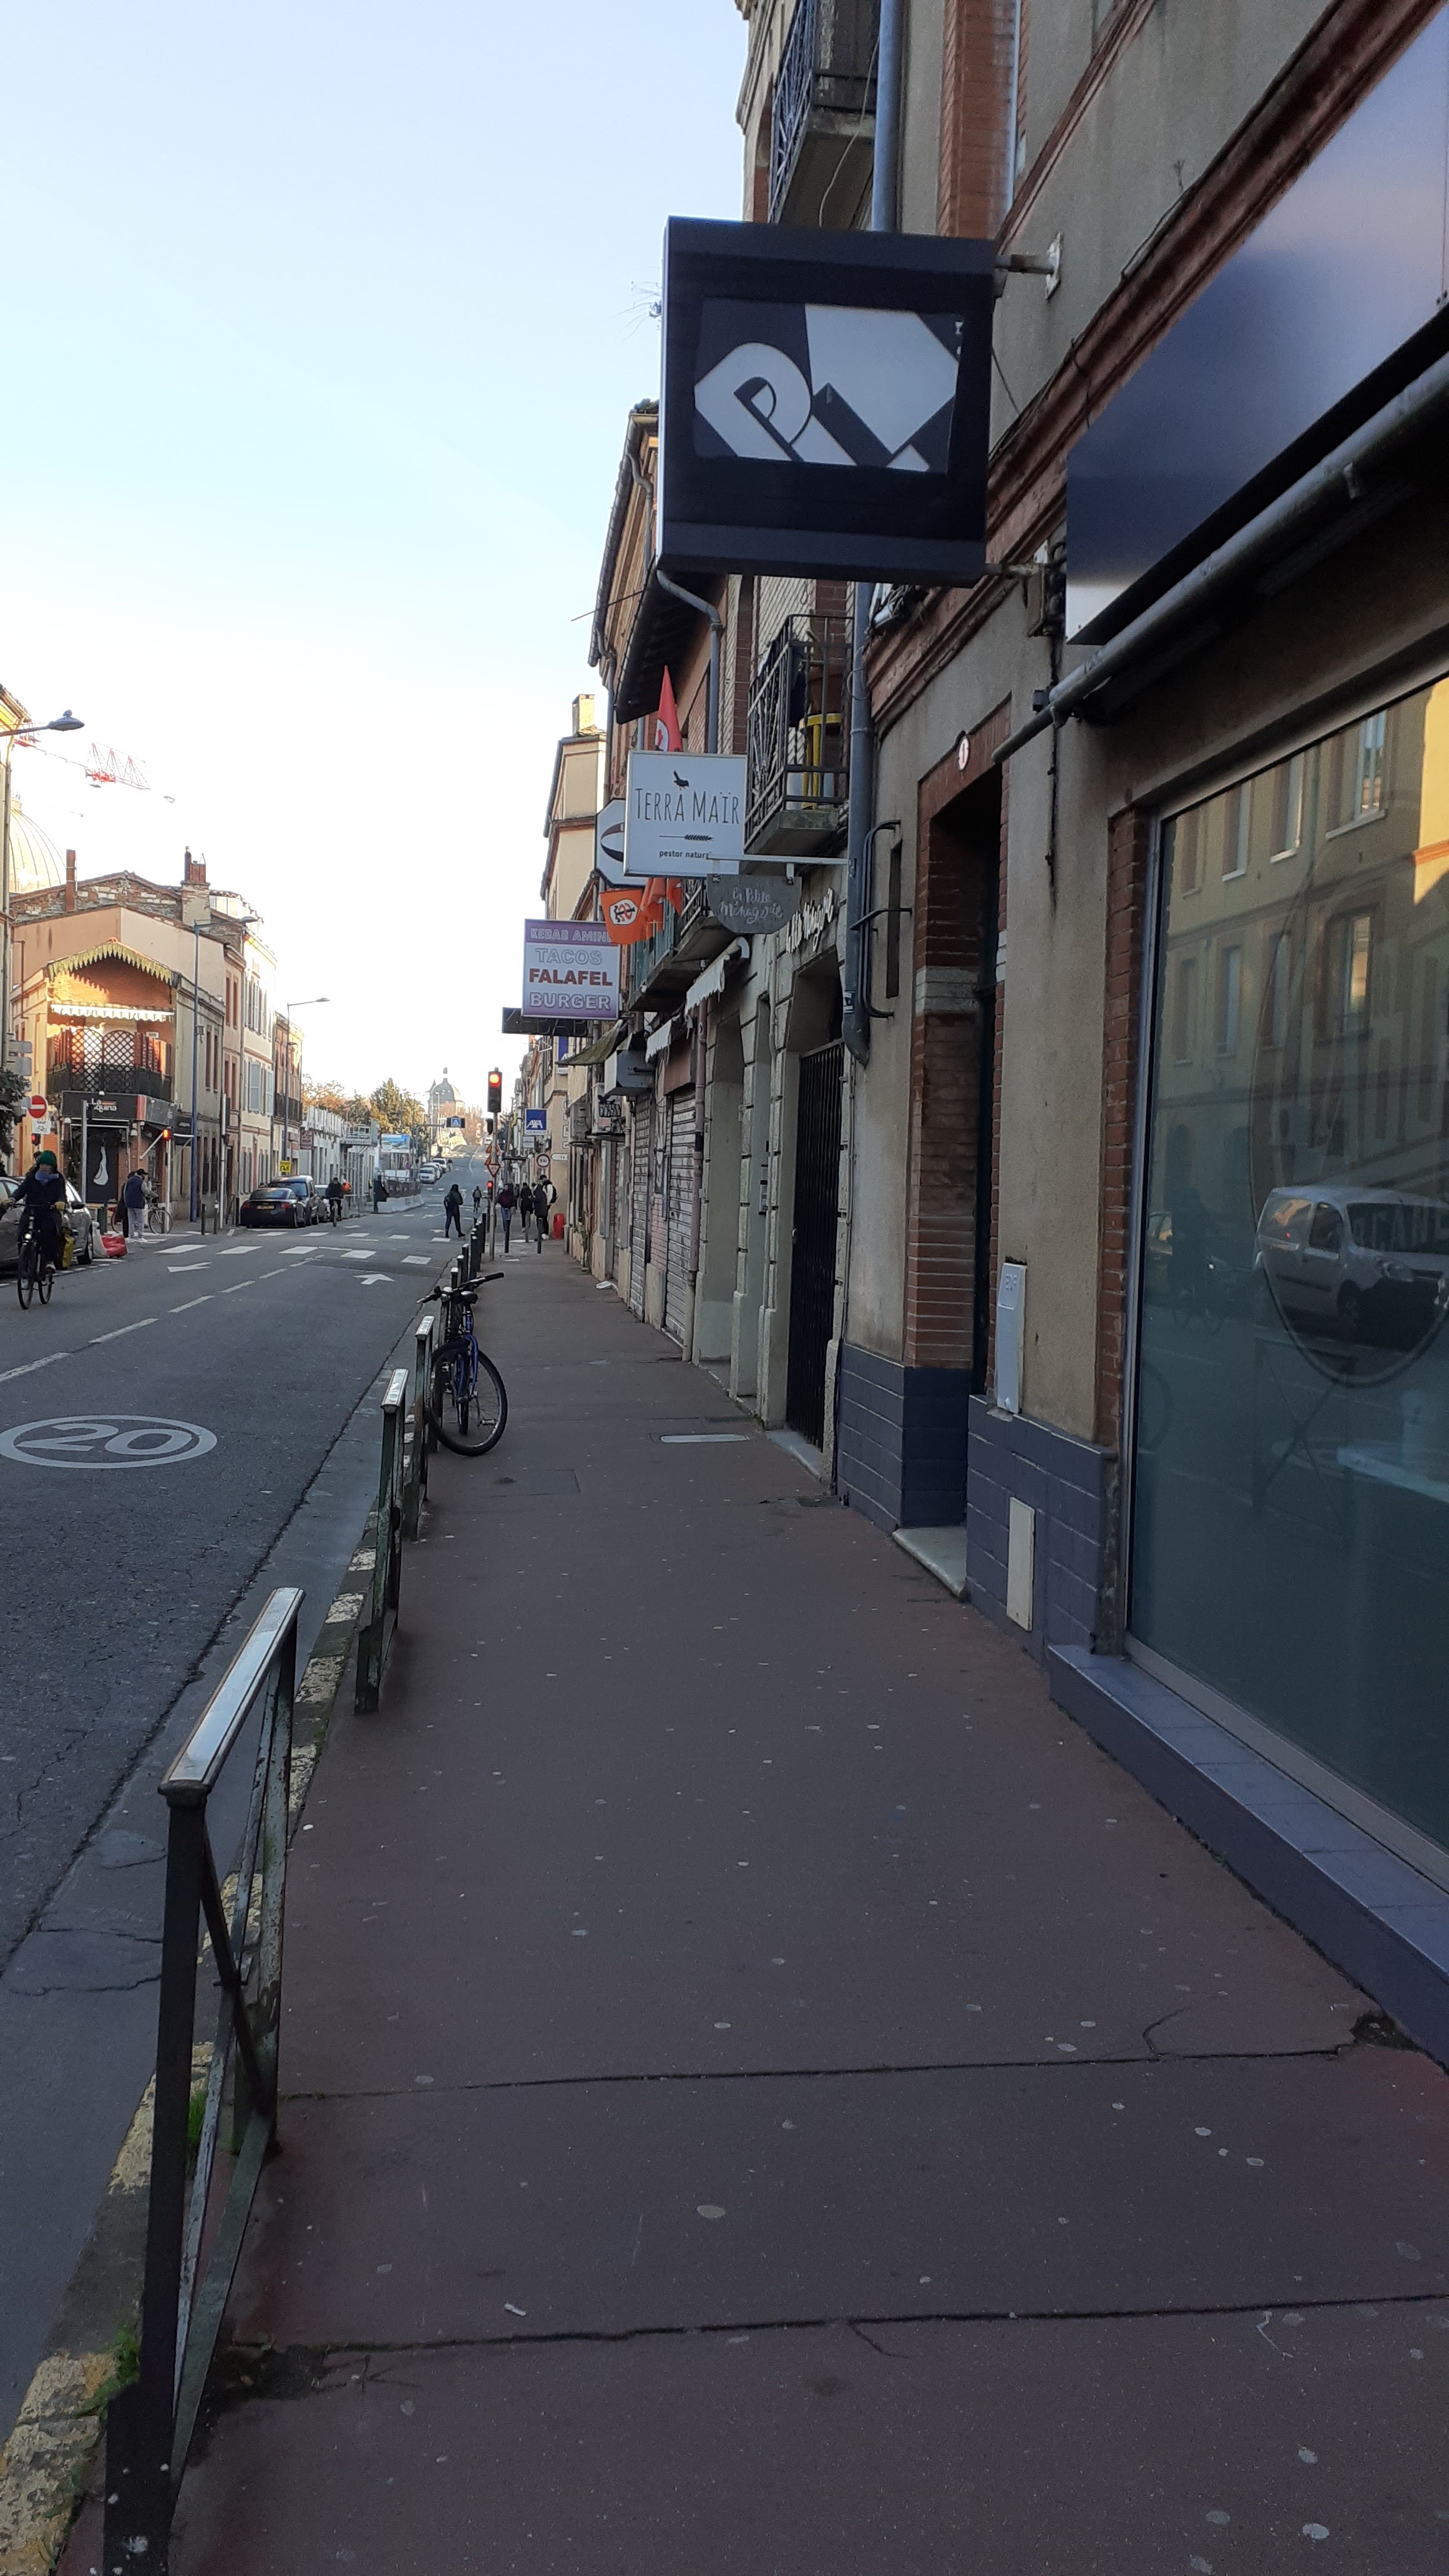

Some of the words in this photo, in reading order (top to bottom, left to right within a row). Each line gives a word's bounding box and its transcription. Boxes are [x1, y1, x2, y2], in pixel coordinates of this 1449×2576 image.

[635, 788, 685, 822] TERRA
[692, 791, 740, 825] MAÏR
[530, 928, 569, 941] KEBAB
[535, 947, 603, 965] TACOS
[529, 968, 613, 987] FALAFEL
[530, 992, 611, 1011] BURGER
[526, 1120, 543, 1128] AXA
[15, 1422, 193, 1455] 20
